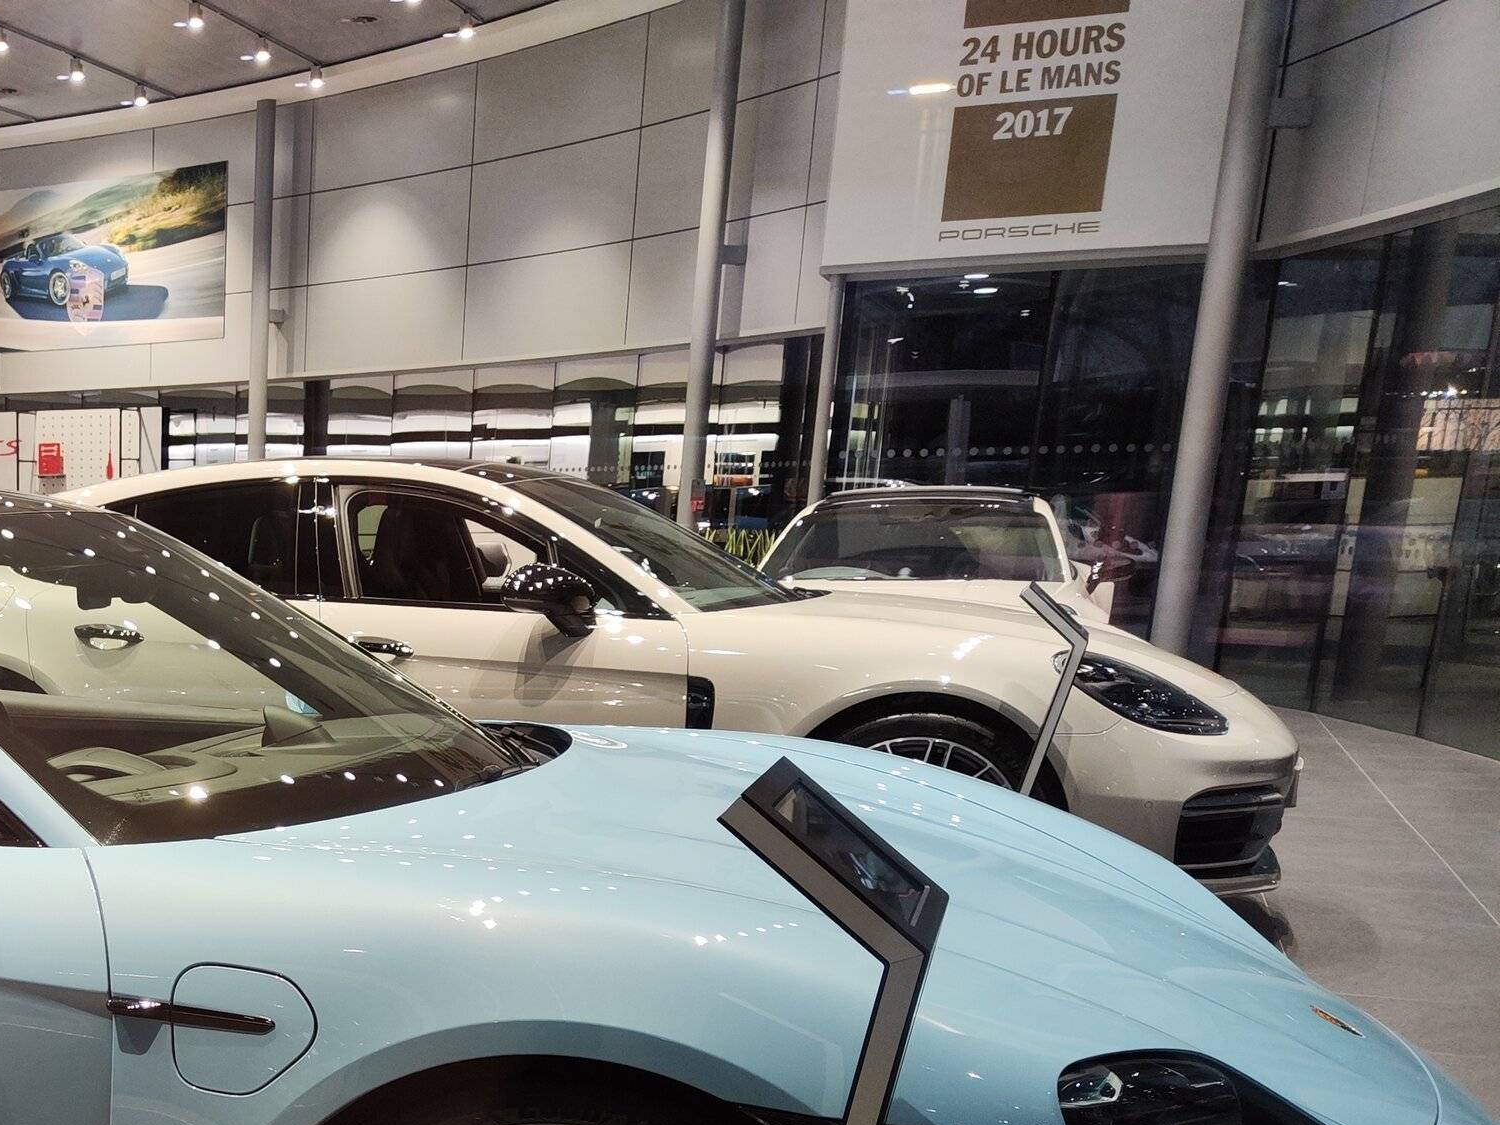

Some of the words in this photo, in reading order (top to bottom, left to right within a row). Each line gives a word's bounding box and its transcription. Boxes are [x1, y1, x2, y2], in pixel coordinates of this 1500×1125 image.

[959, 34, 1001, 66] 24
[1012, 22, 1126, 61] HOURS
[956, 72, 992, 98] OF
[999, 68, 1032, 94] LE
[1040, 60, 1121, 90] MANS
[992, 106, 1074, 141] 2017
[938, 220, 1101, 242] PORSCHE
